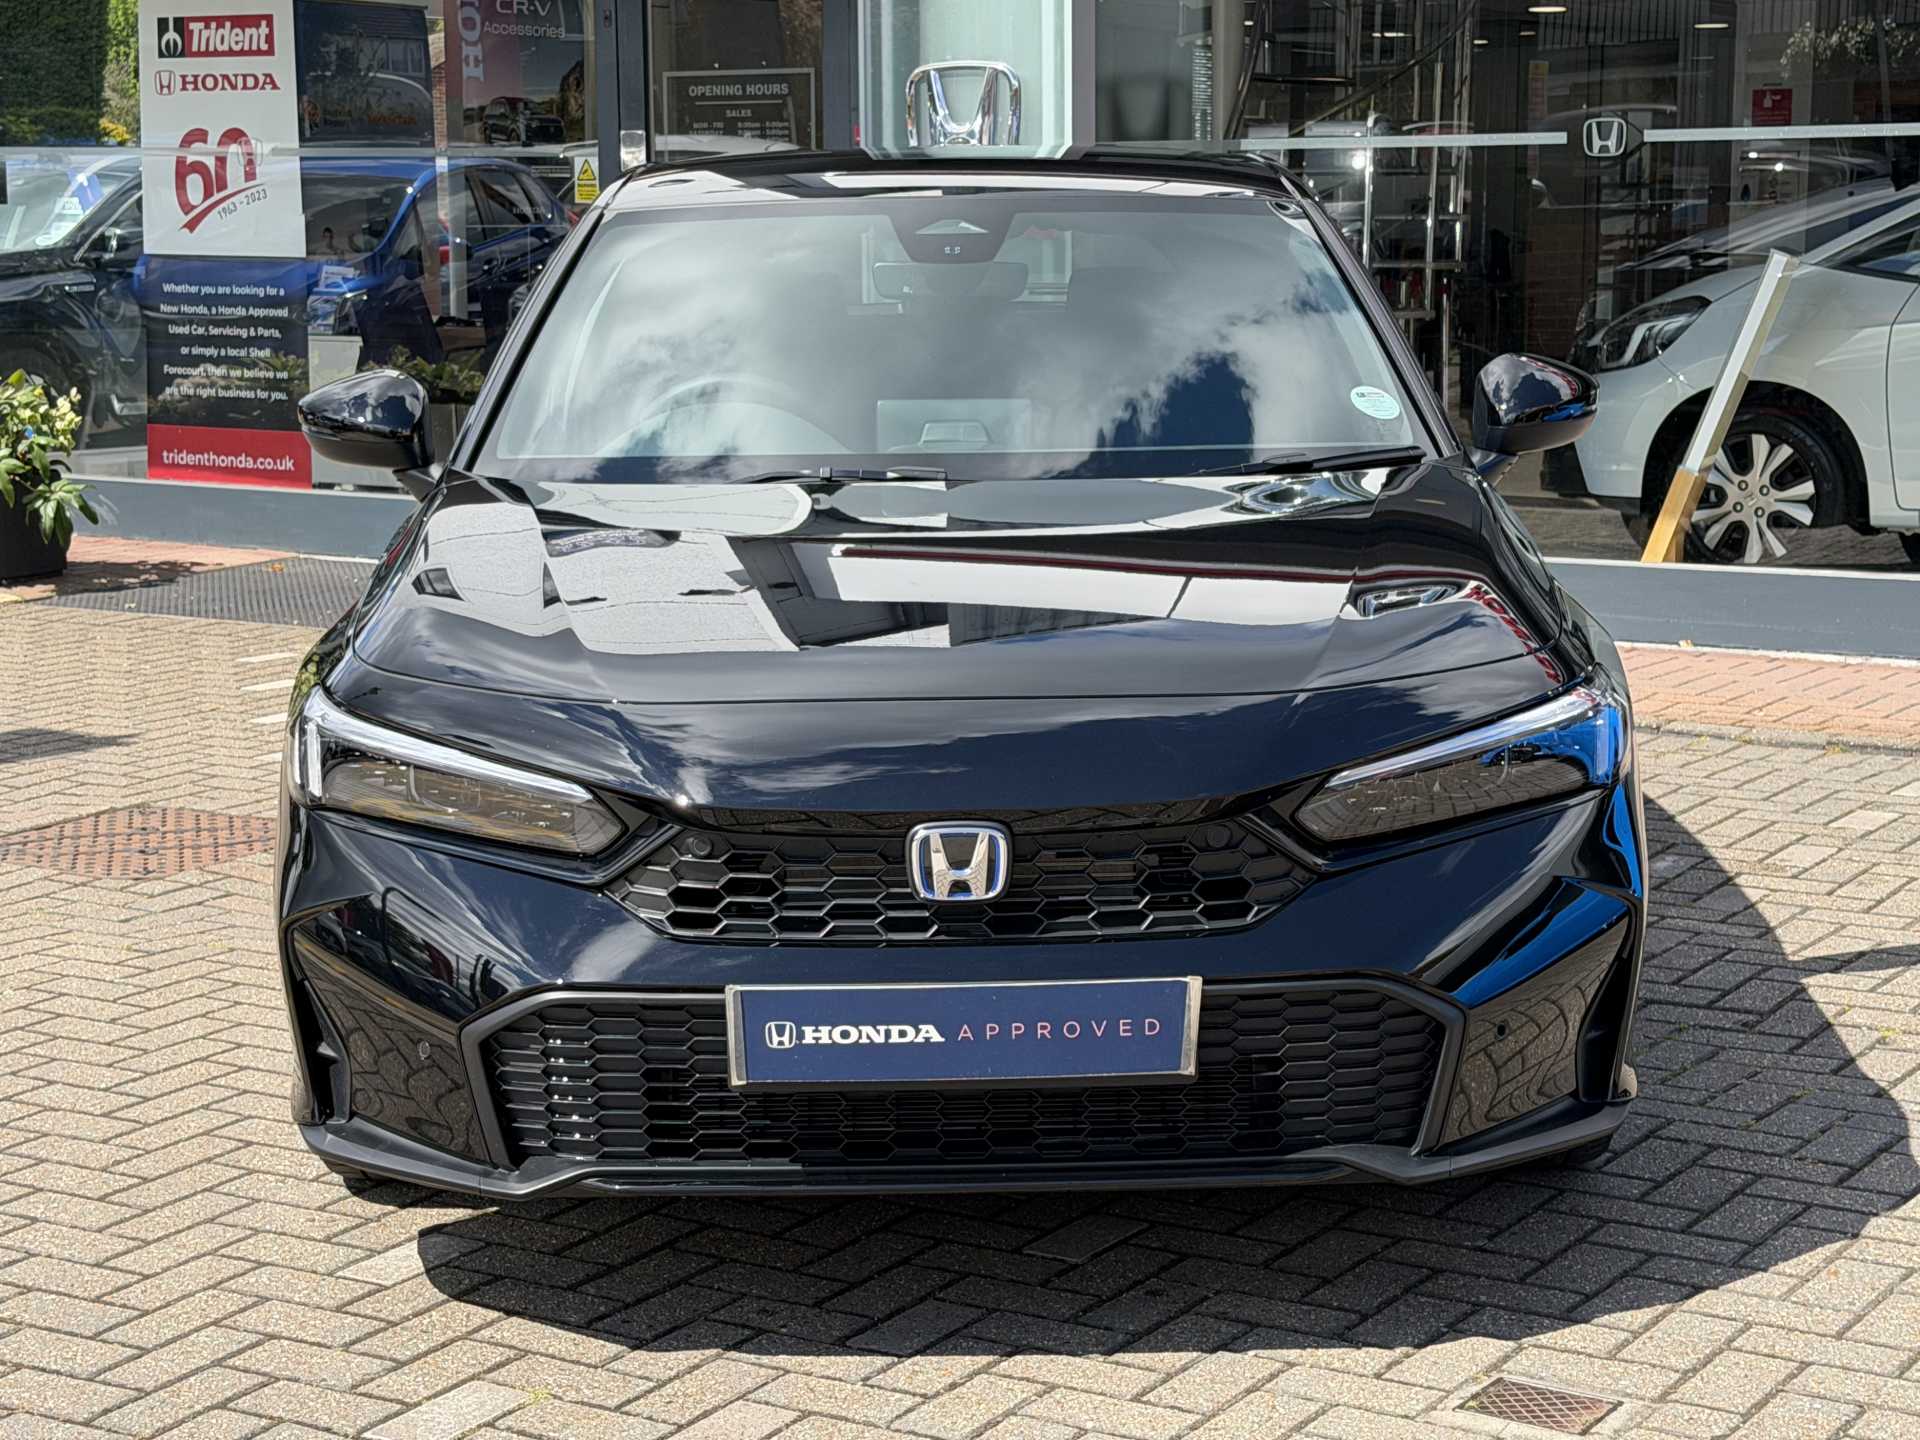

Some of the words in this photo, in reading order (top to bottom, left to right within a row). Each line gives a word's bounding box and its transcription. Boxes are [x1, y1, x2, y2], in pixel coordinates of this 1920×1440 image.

[189, 20, 269, 52] Trident
[482, 21, 566, 39] Accessories
[179, 73, 281, 92] HONDA
[688, 84, 743, 97] OPENING
[745, 83, 790, 96] HOURS
[162, 282, 199, 294] Whether
[200, 286, 216, 297] you
[217, 286, 231, 295] are
[232, 284, 265, 298] looking
[266, 285, 278, 296] for
[279, 287, 286, 296] a
[160, 303, 179, 313] New
[180, 304, 209, 317] Honda,
[211, 306, 217, 315] a
[218, 305, 247, 316] Honda
[248, 306, 289, 319] Approved
[168, 324, 190, 335] Used
[191, 324, 208, 337] Car,
[208, 325, 248, 339] Servicing
[249, 326, 256, 337] &
[257, 326, 282, 339] Parts,
[180, 346, 190, 355] or
[191, 344, 220, 358] simply
[220, 347, 226, 356] a
[227, 346, 248, 357] local
[249, 347, 271, 358] Shell
[207, 367, 228, 377] then
[229, 369, 242, 378] we
[243, 367, 274, 379] believe
[275, 370, 289, 380] we
[165, 386, 178, 396] are
[180, 385, 194, 396] the
[196, 386, 216, 400] right
[218, 387, 256, 399] business
[257, 388, 270, 400] for
[270, 391, 289, 404] you.
[162, 449, 296, 472] tridenthonda.co.uk
[801, 1024, 946, 1045] HONDA
[957, 1018, 1162, 1042] APPROVED
